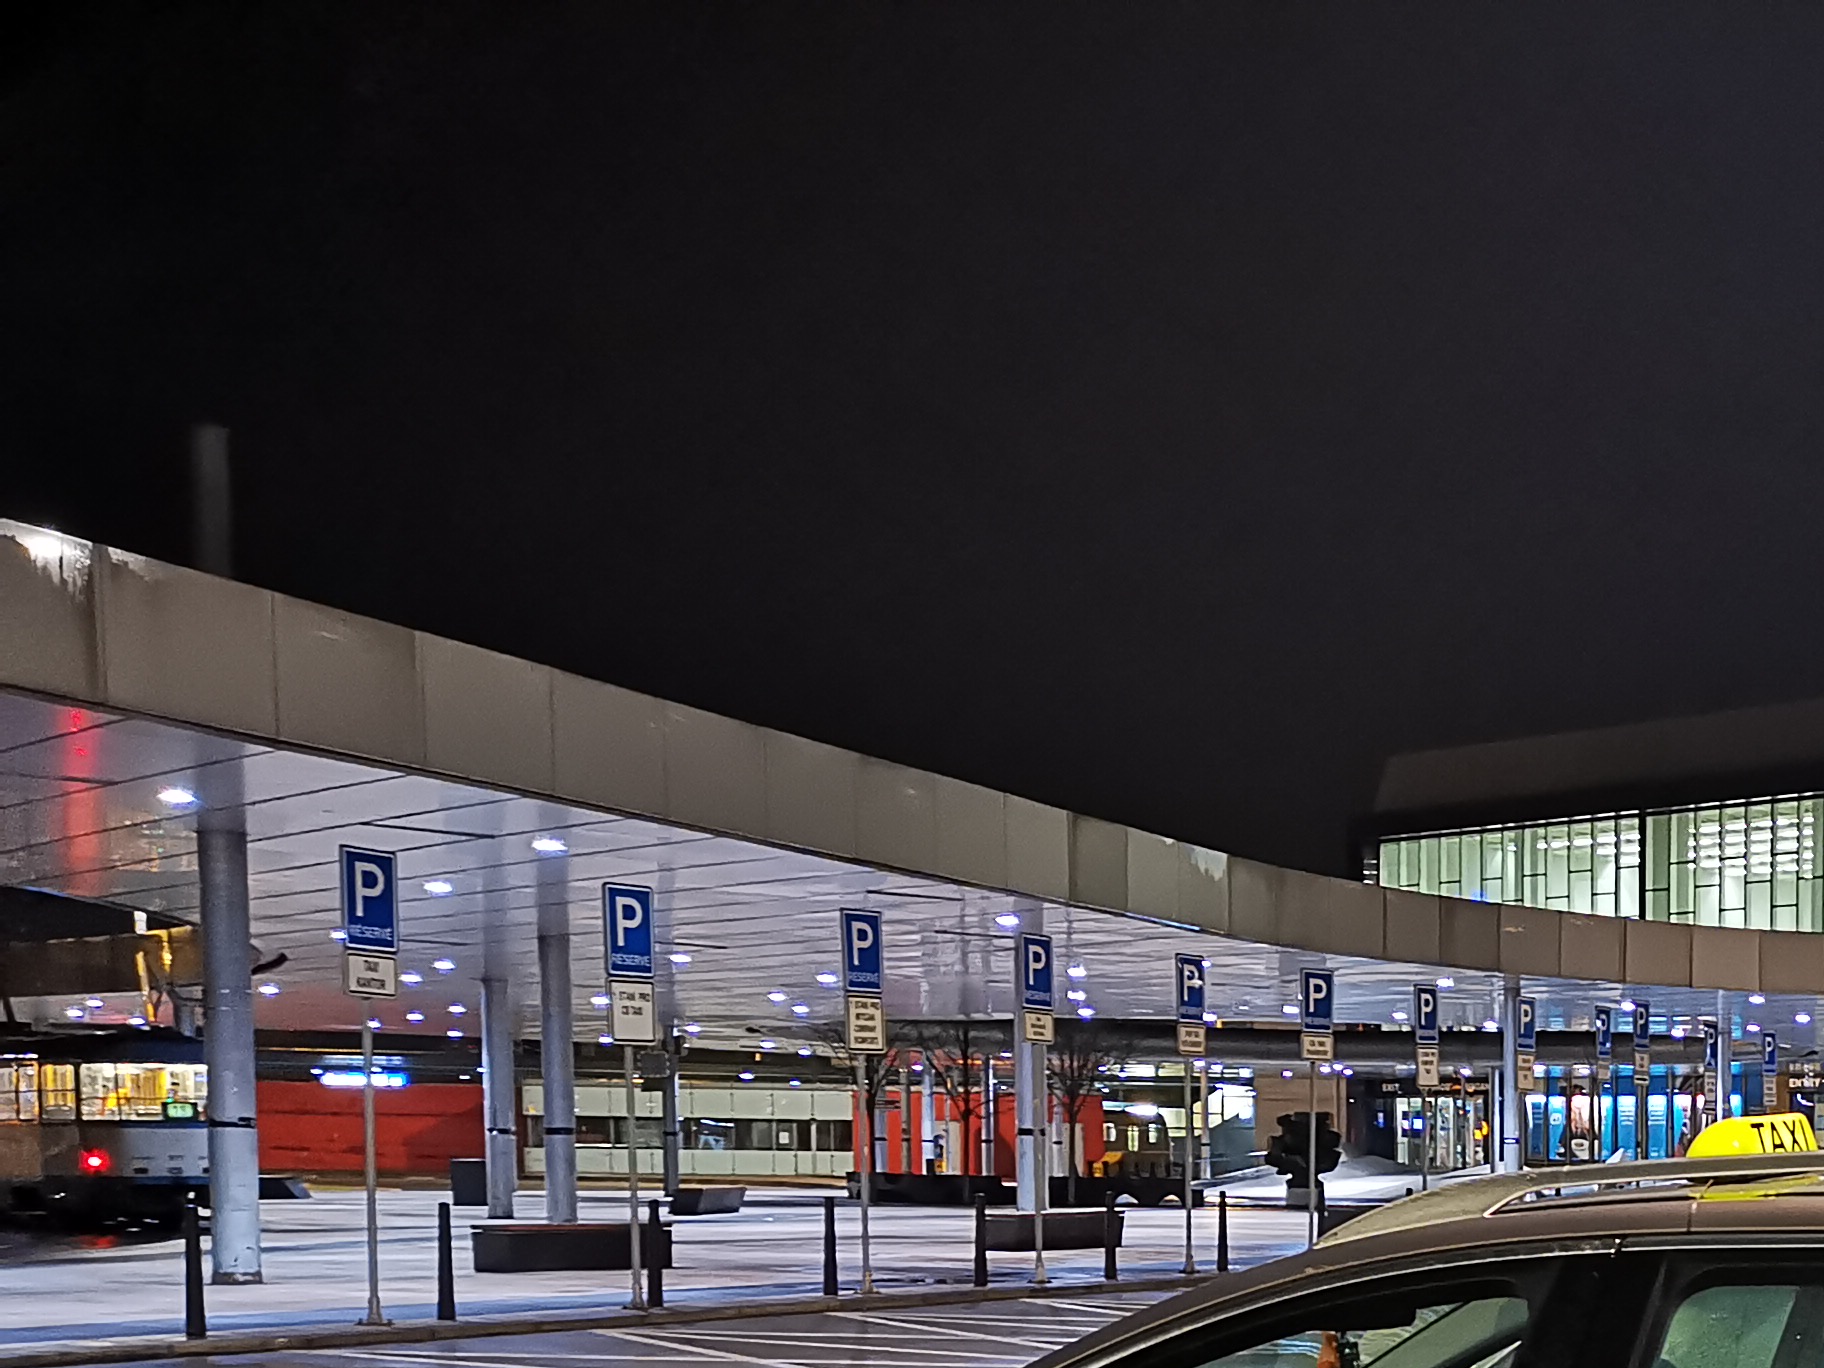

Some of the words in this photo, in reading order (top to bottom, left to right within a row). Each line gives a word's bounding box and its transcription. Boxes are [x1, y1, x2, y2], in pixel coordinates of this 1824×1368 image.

[354, 861, 385, 917] P
[615, 896, 643, 946] P
[851, 921, 874, 966] P
[1028, 944, 1046, 985] P
[1308, 977, 1327, 1013] P
[1420, 993, 1434, 1026] P
[1520, 1004, 1533, 1034] P
[1636, 1007, 1647, 1040] P
[1765, 1036, 1775, 1063] P
[1750, 1120, 1810, 1153] TAXI
